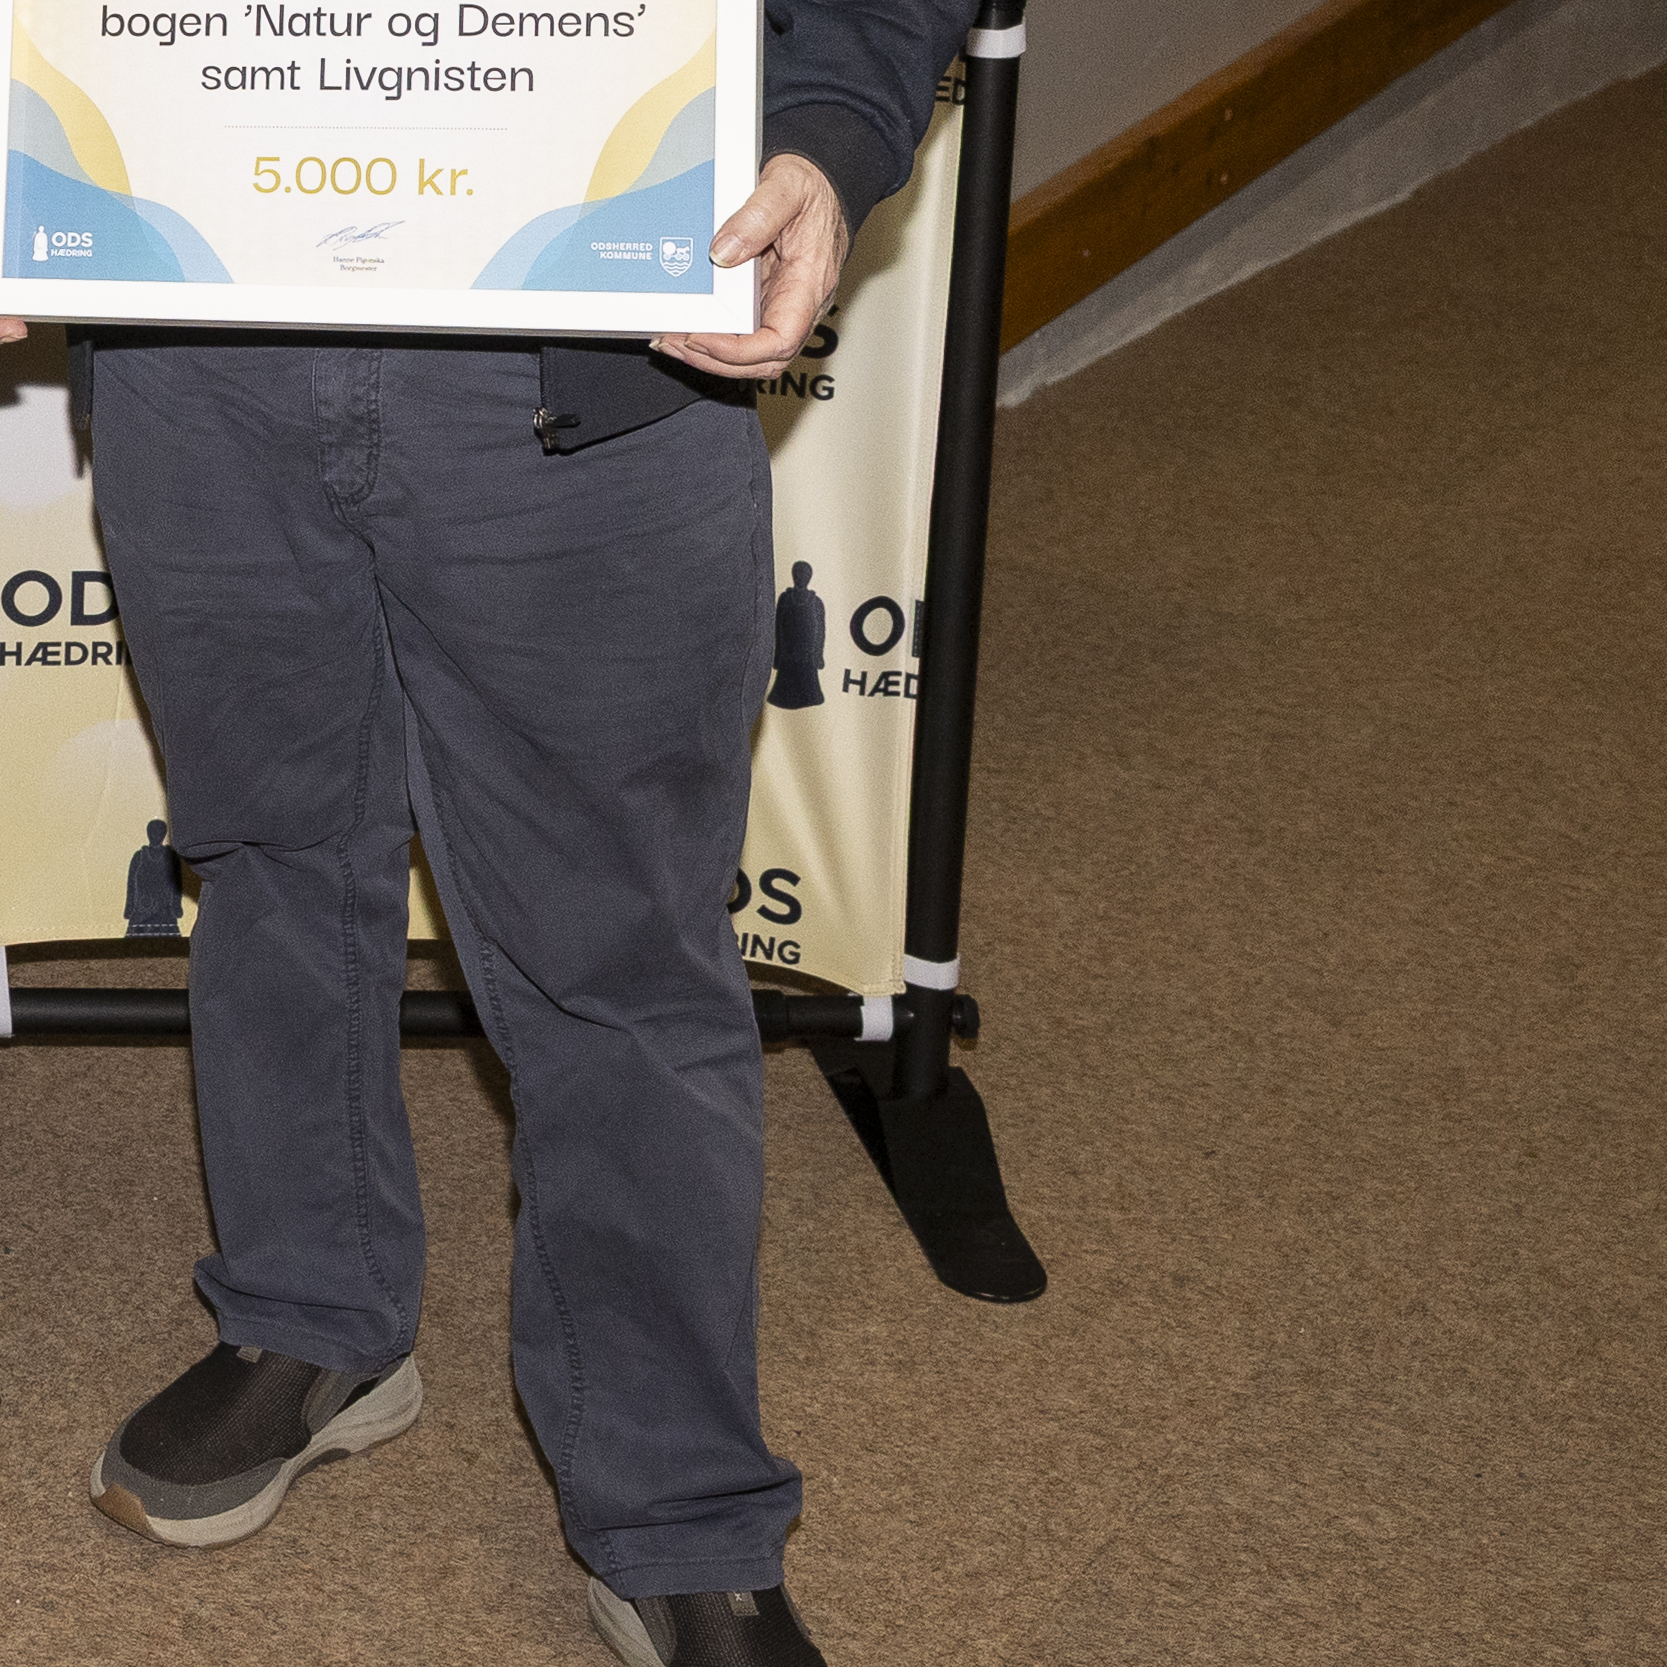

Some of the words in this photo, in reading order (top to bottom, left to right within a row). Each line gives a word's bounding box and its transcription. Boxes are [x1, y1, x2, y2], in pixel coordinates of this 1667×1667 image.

[101, 5, 228, 46] bogen
[387, 12, 440, 46] og
[202, 61, 301, 91] samt
[319, 58, 534, 100] Livgnisten
[253, 157, 397, 196] 5.000
[418, 159, 474, 196] kr.
[52, 232, 93, 248] ODS
[590, 242, 653, 251] ODSHERRED
[600, 251, 653, 260] KOMMUNE
[1, 570, 120, 627] OD
